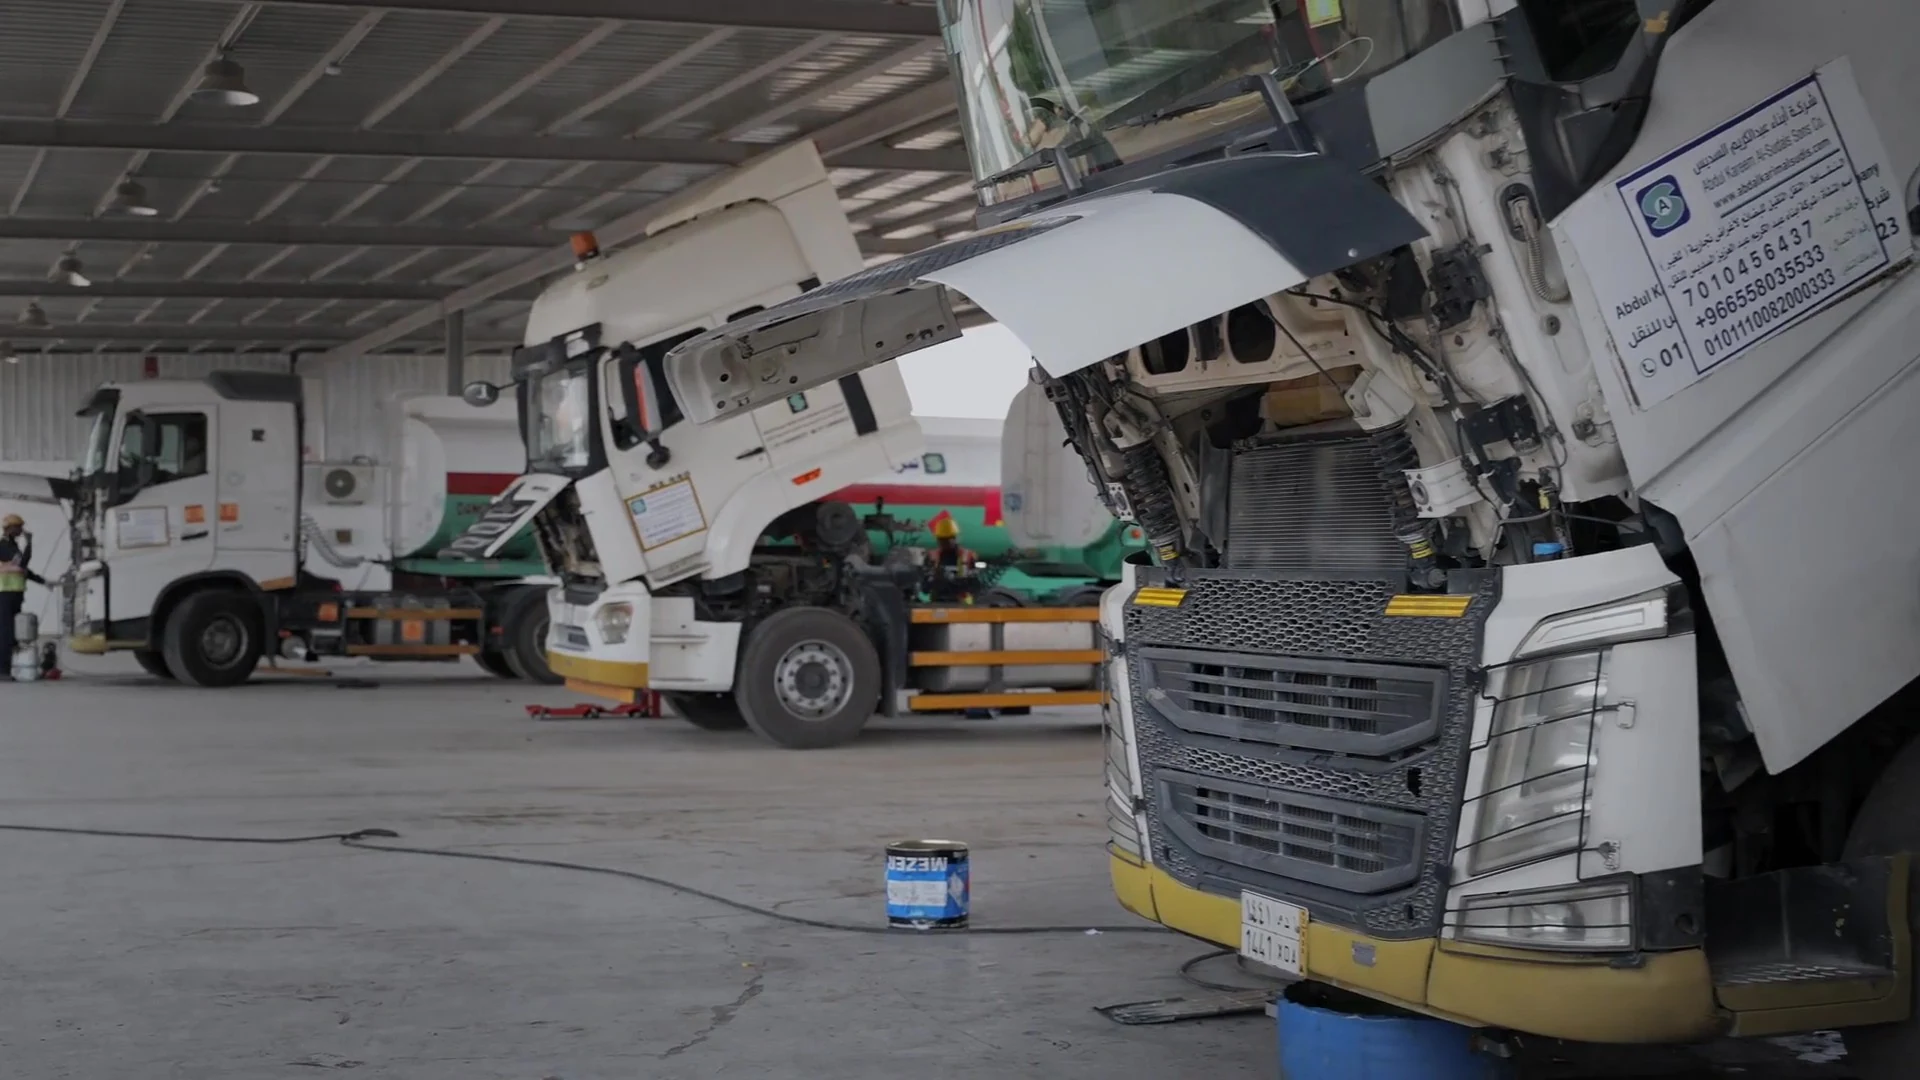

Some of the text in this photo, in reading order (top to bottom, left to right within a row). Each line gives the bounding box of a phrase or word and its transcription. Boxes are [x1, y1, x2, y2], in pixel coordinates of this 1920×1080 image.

[1701, 171, 1725, 192] Abdul
[1724, 156, 1755, 178] Kareem
[1756, 135, 1792, 162] Al-Sudais
[1791, 123, 1812, 142] Sons
[1877, 216, 1899, 240] 23
[1696, 244, 1824, 327] +966558035533
[1615, 289, 1651, 319] Abdul
[1704, 268, 1834, 355] 0101110082000333
[1628, 318, 1662, 348] للنقل
[1659, 341, 1683, 367] 01
